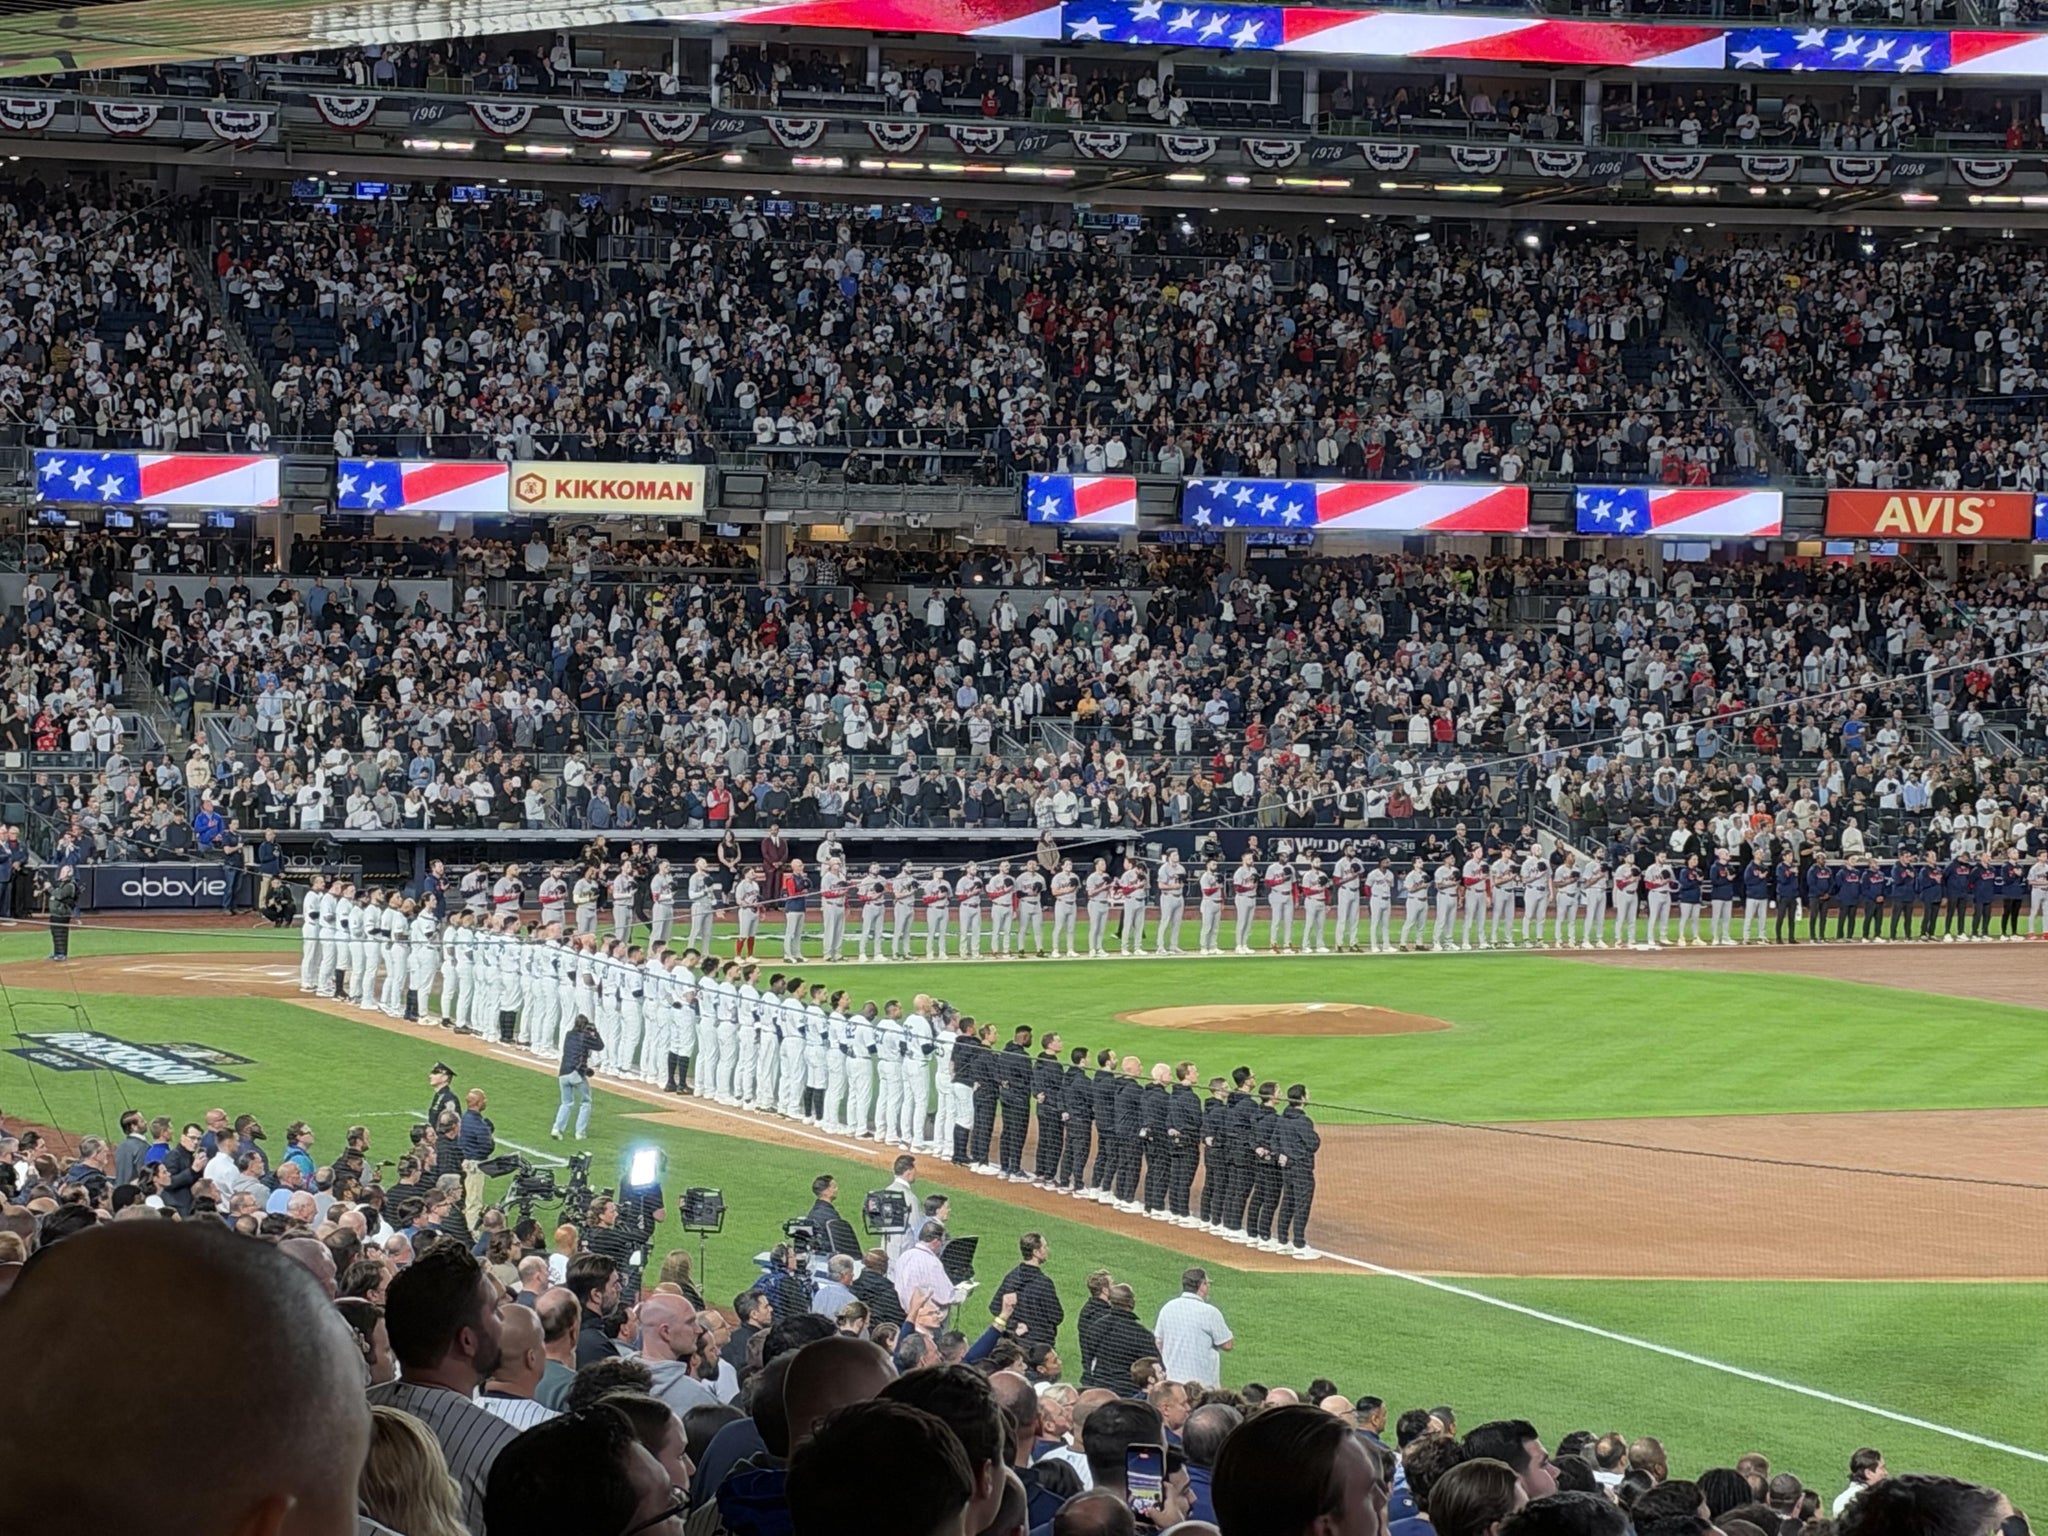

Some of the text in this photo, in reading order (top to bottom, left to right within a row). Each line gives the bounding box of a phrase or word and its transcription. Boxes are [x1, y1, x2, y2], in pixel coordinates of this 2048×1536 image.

[412, 105, 445, 122] 1961
[710, 119, 745, 132] 1962
[1017, 135, 1048, 152] 1977
[1311, 146, 1342, 159] 1978
[1592, 161, 1622, 175] 1996
[1892, 163, 1925, 175] 1998
[555, 479, 693, 501] KIKKOMAN
[1873, 496, 1985, 535] AVIS
[1295, 837, 1339, 854] WILD
[121, 877, 227, 897] abbvie
